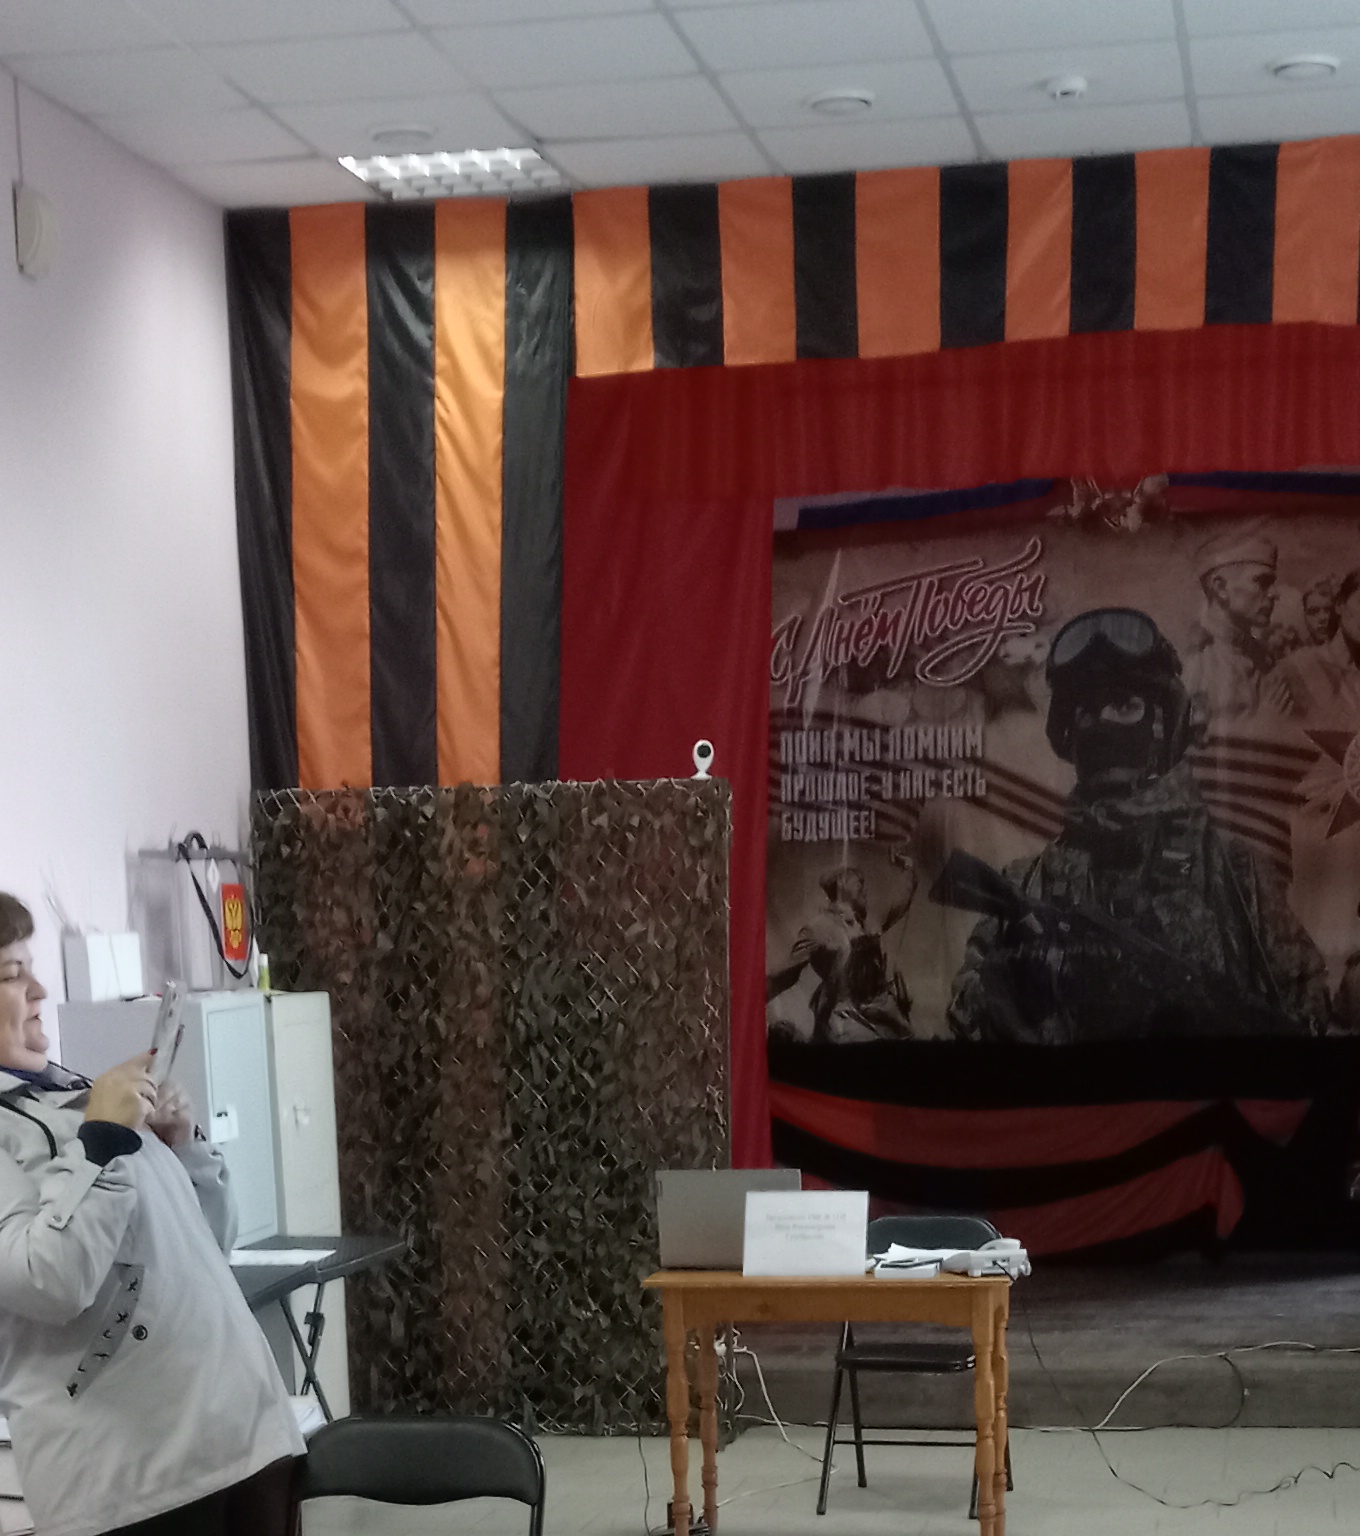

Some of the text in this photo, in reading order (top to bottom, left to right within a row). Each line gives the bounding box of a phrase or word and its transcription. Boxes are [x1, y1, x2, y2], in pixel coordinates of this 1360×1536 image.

[838, 536, 1045, 687] Победы
[844, 728, 881, 762] МЫ
[890, 724, 984, 760] ПОМНИМ
[781, 771, 870, 804] ПРОШЛОЕ
[881, 770, 894, 801] У
[900, 768, 936, 800] НАС
[943, 766, 987, 798] ЕСТЬ
[781, 809, 876, 842] БУДУЩЕЕ!
